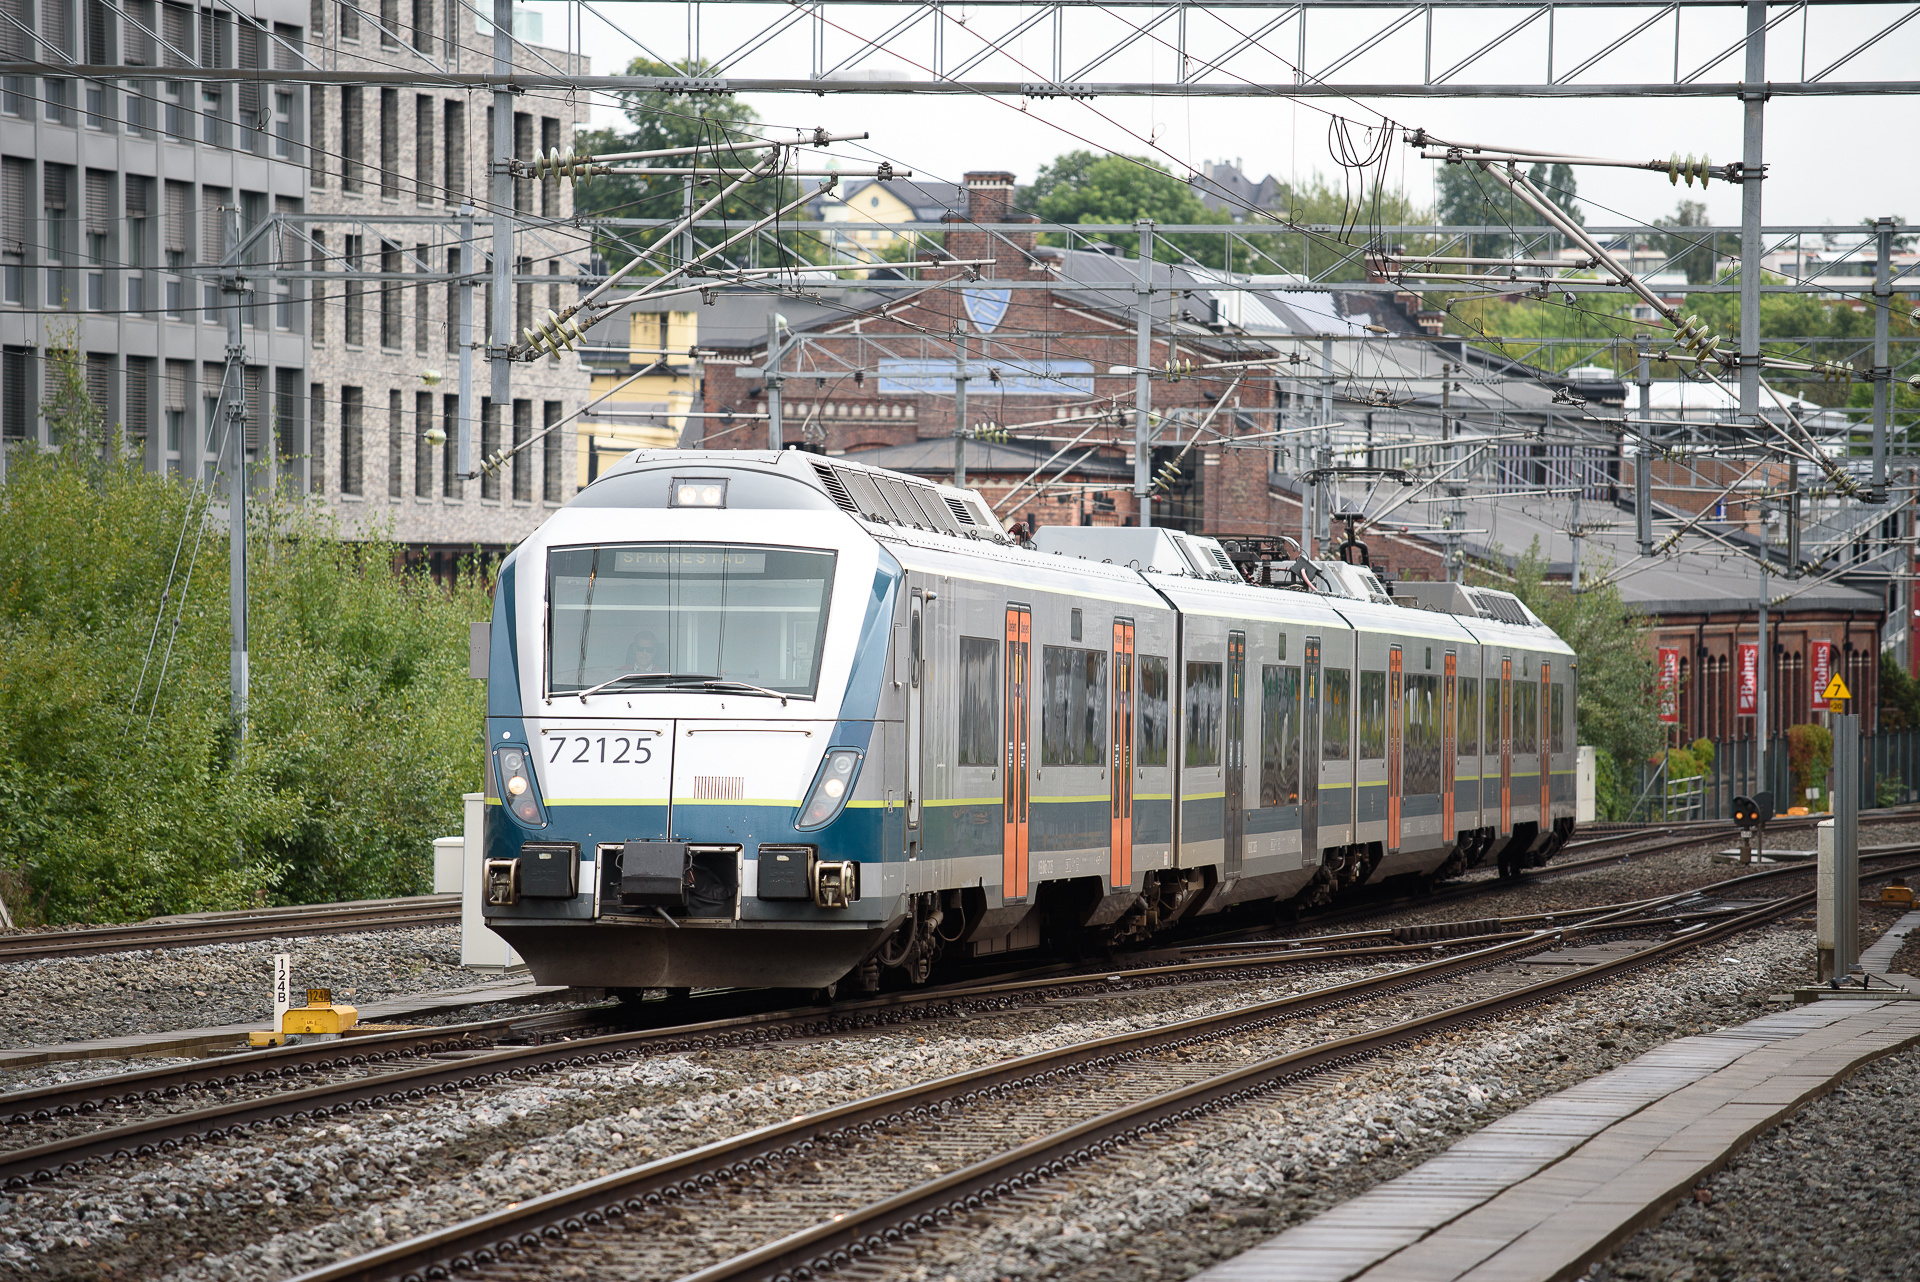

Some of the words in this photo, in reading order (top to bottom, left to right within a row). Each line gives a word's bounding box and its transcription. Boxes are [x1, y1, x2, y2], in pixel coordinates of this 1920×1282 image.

[623, 552, 746, 565] SPIKKESTAD
[1741, 649, 1755, 694] Bohus
[1814, 646, 1828, 690] Bohus
[1833, 684, 1841, 696] 7
[549, 737, 652, 764] 72125
[277, 958, 286, 1003] 124B
